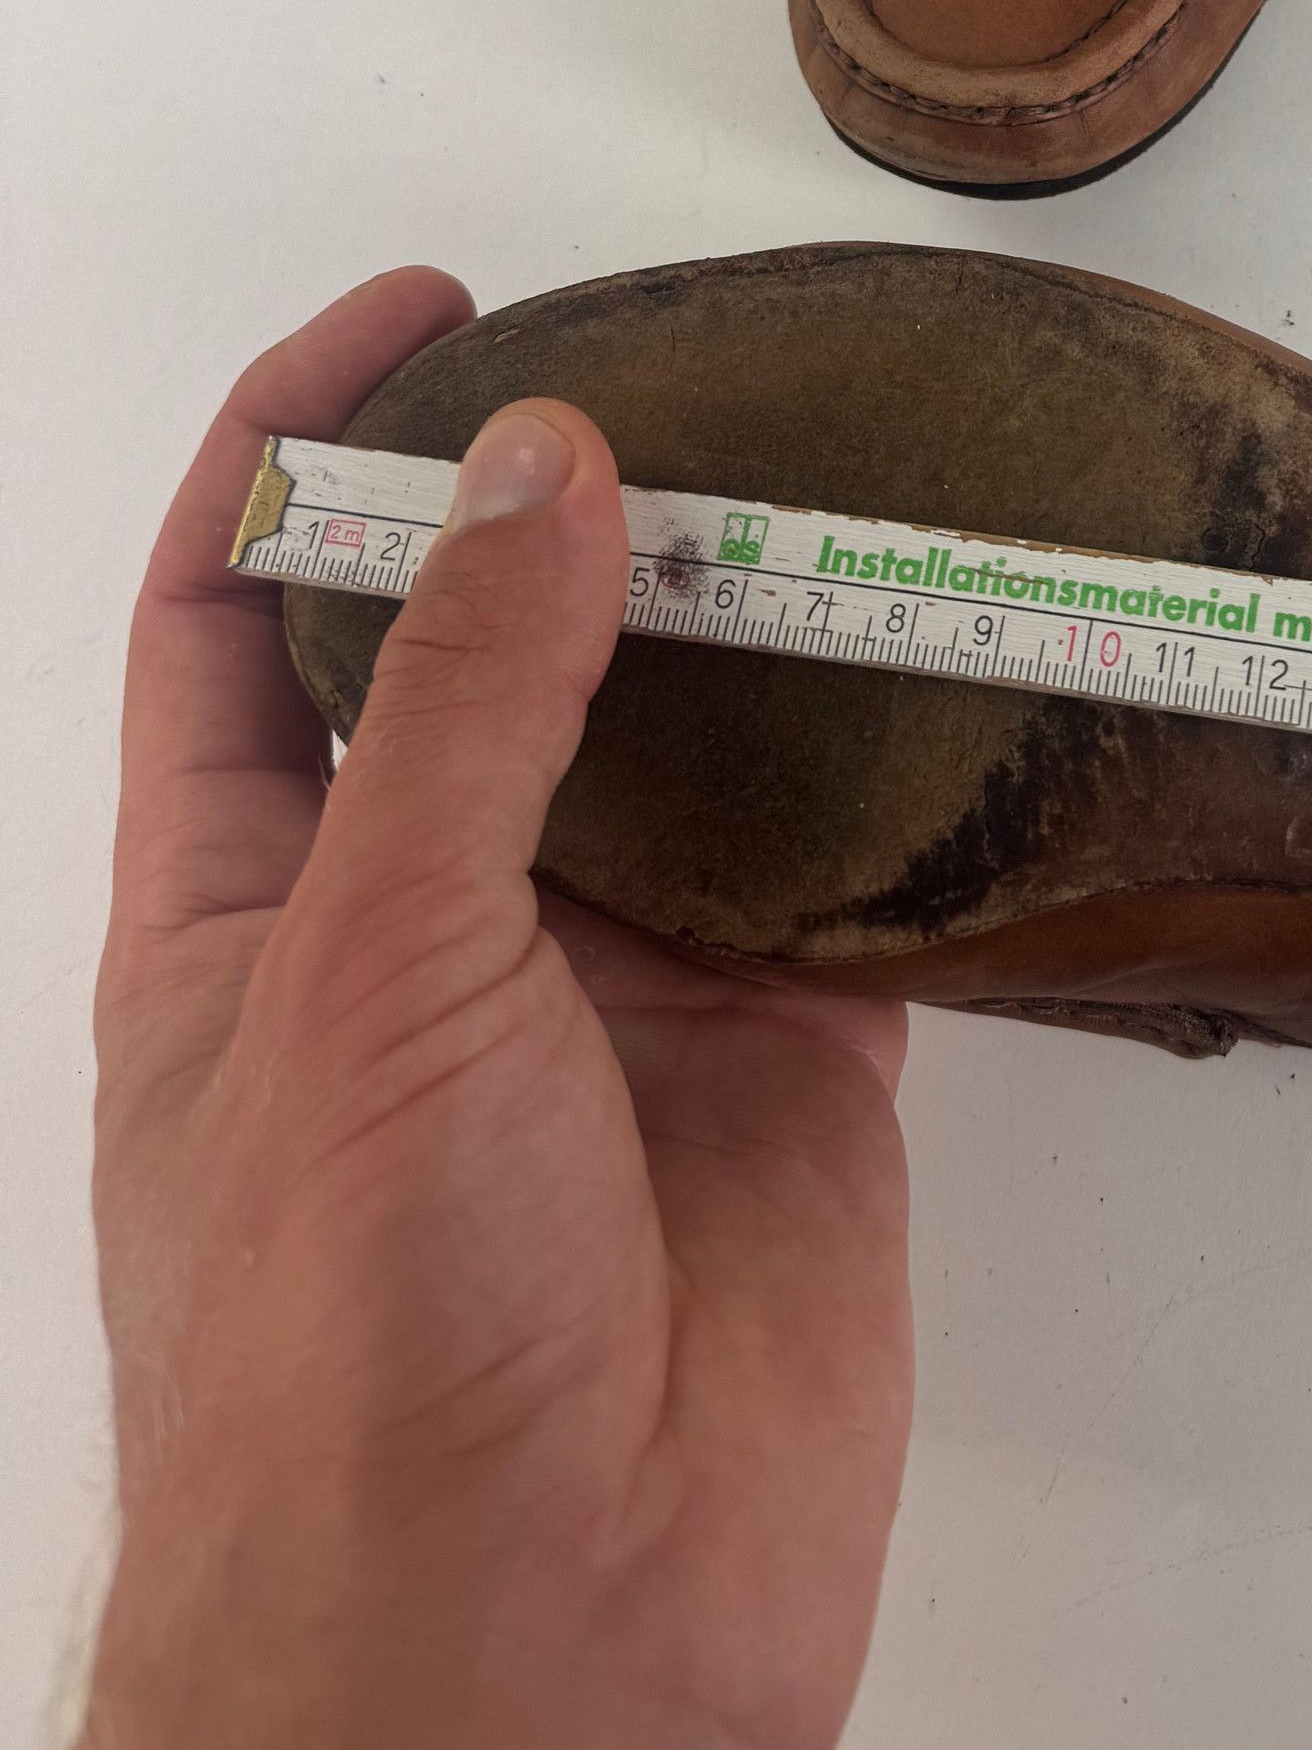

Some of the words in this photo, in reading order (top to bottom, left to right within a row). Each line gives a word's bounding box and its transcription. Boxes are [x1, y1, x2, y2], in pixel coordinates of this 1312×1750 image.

[309, 521, 319, 549] 1
[380, 532, 401, 561] 2
[629, 567, 650, 596] 5
[715, 579, 736, 609] 6
[806, 591, 824, 621] 7
[886, 603, 906, 633] 8
[973, 615, 993, 646] 9
[1067, 625, 1121, 667] 10
[1156, 643, 1195, 677] 11
[1242, 656, 1289, 691] 12
[816, 535, 1261, 633] Installationsmaterial
